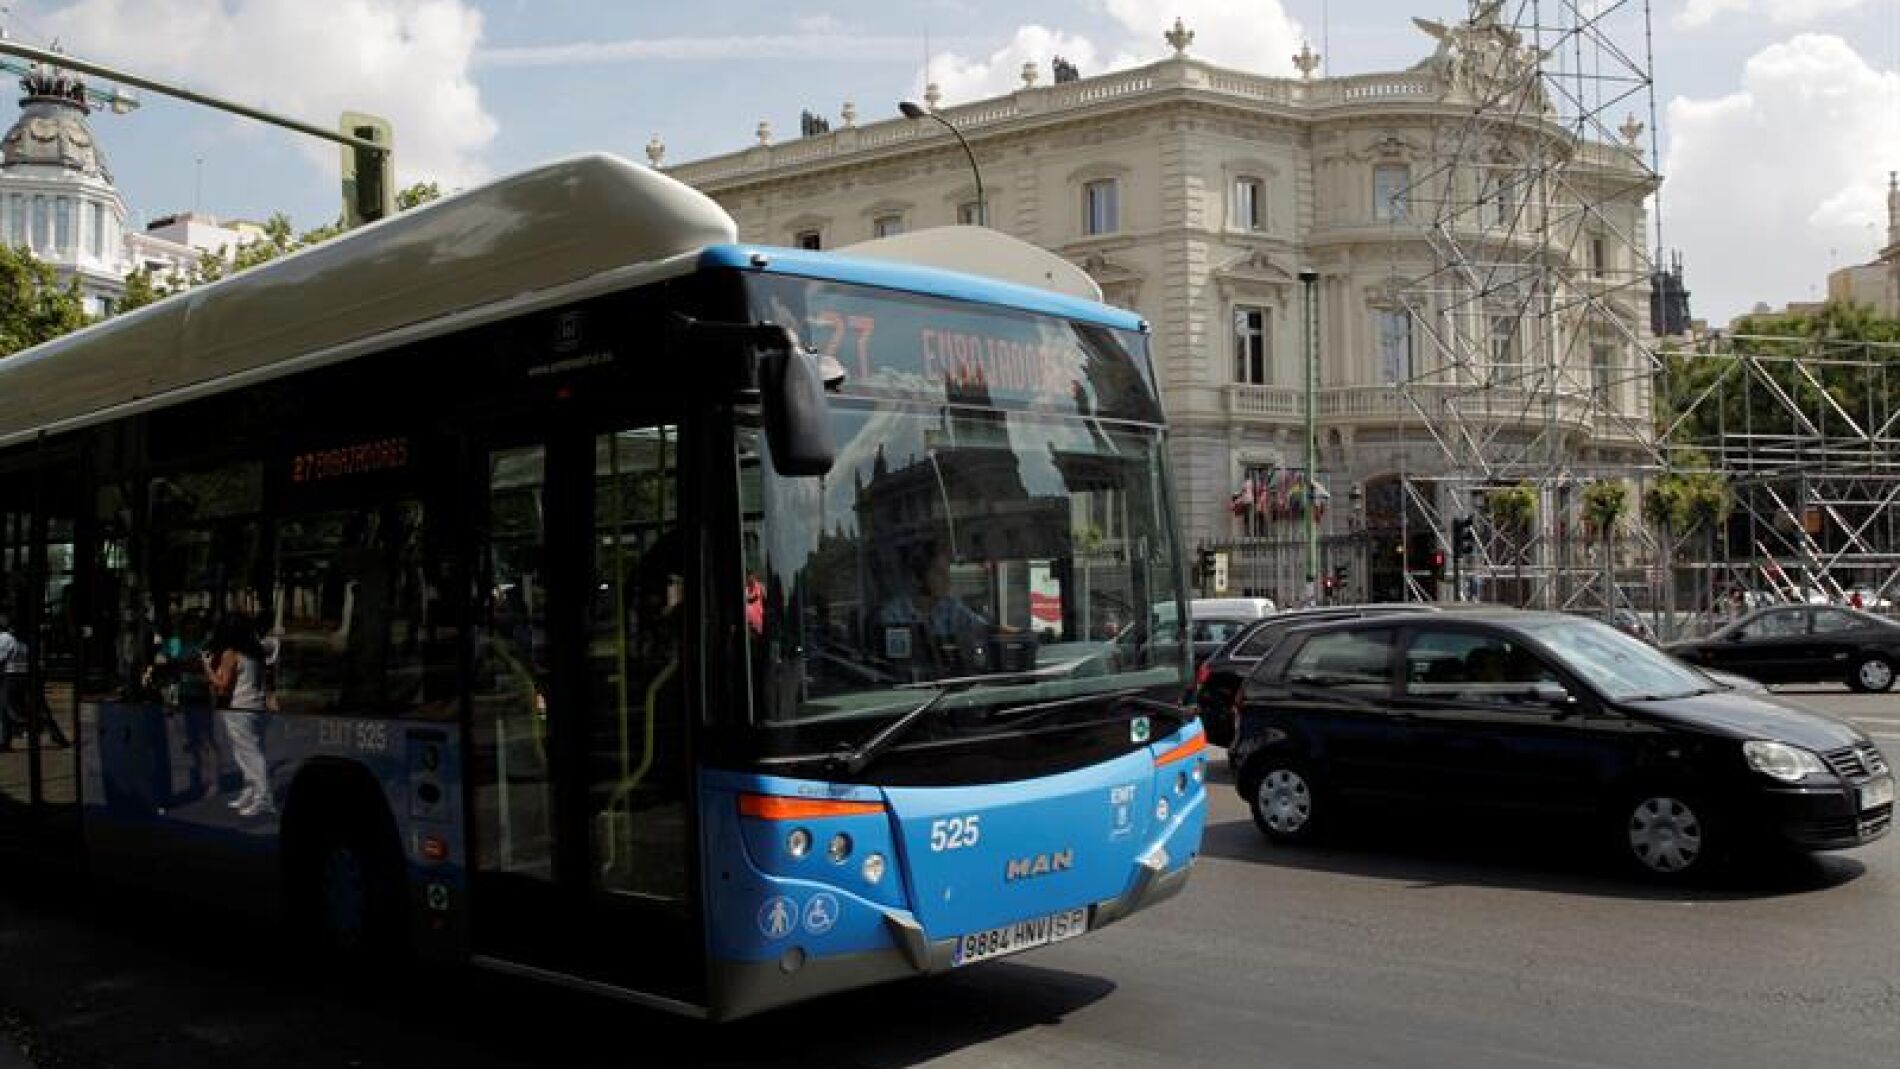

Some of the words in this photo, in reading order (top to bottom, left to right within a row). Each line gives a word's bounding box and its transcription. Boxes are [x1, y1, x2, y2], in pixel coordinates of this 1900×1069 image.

[817, 310, 875, 378] 27
[356, 721, 386, 750] 525
[930, 815, 979, 851] 525
[1006, 848, 1073, 880] MAN
[966, 928, 1009, 958] 9884
[1014, 916, 1048, 944] HNV
[1055, 909, 1084, 937] SP
